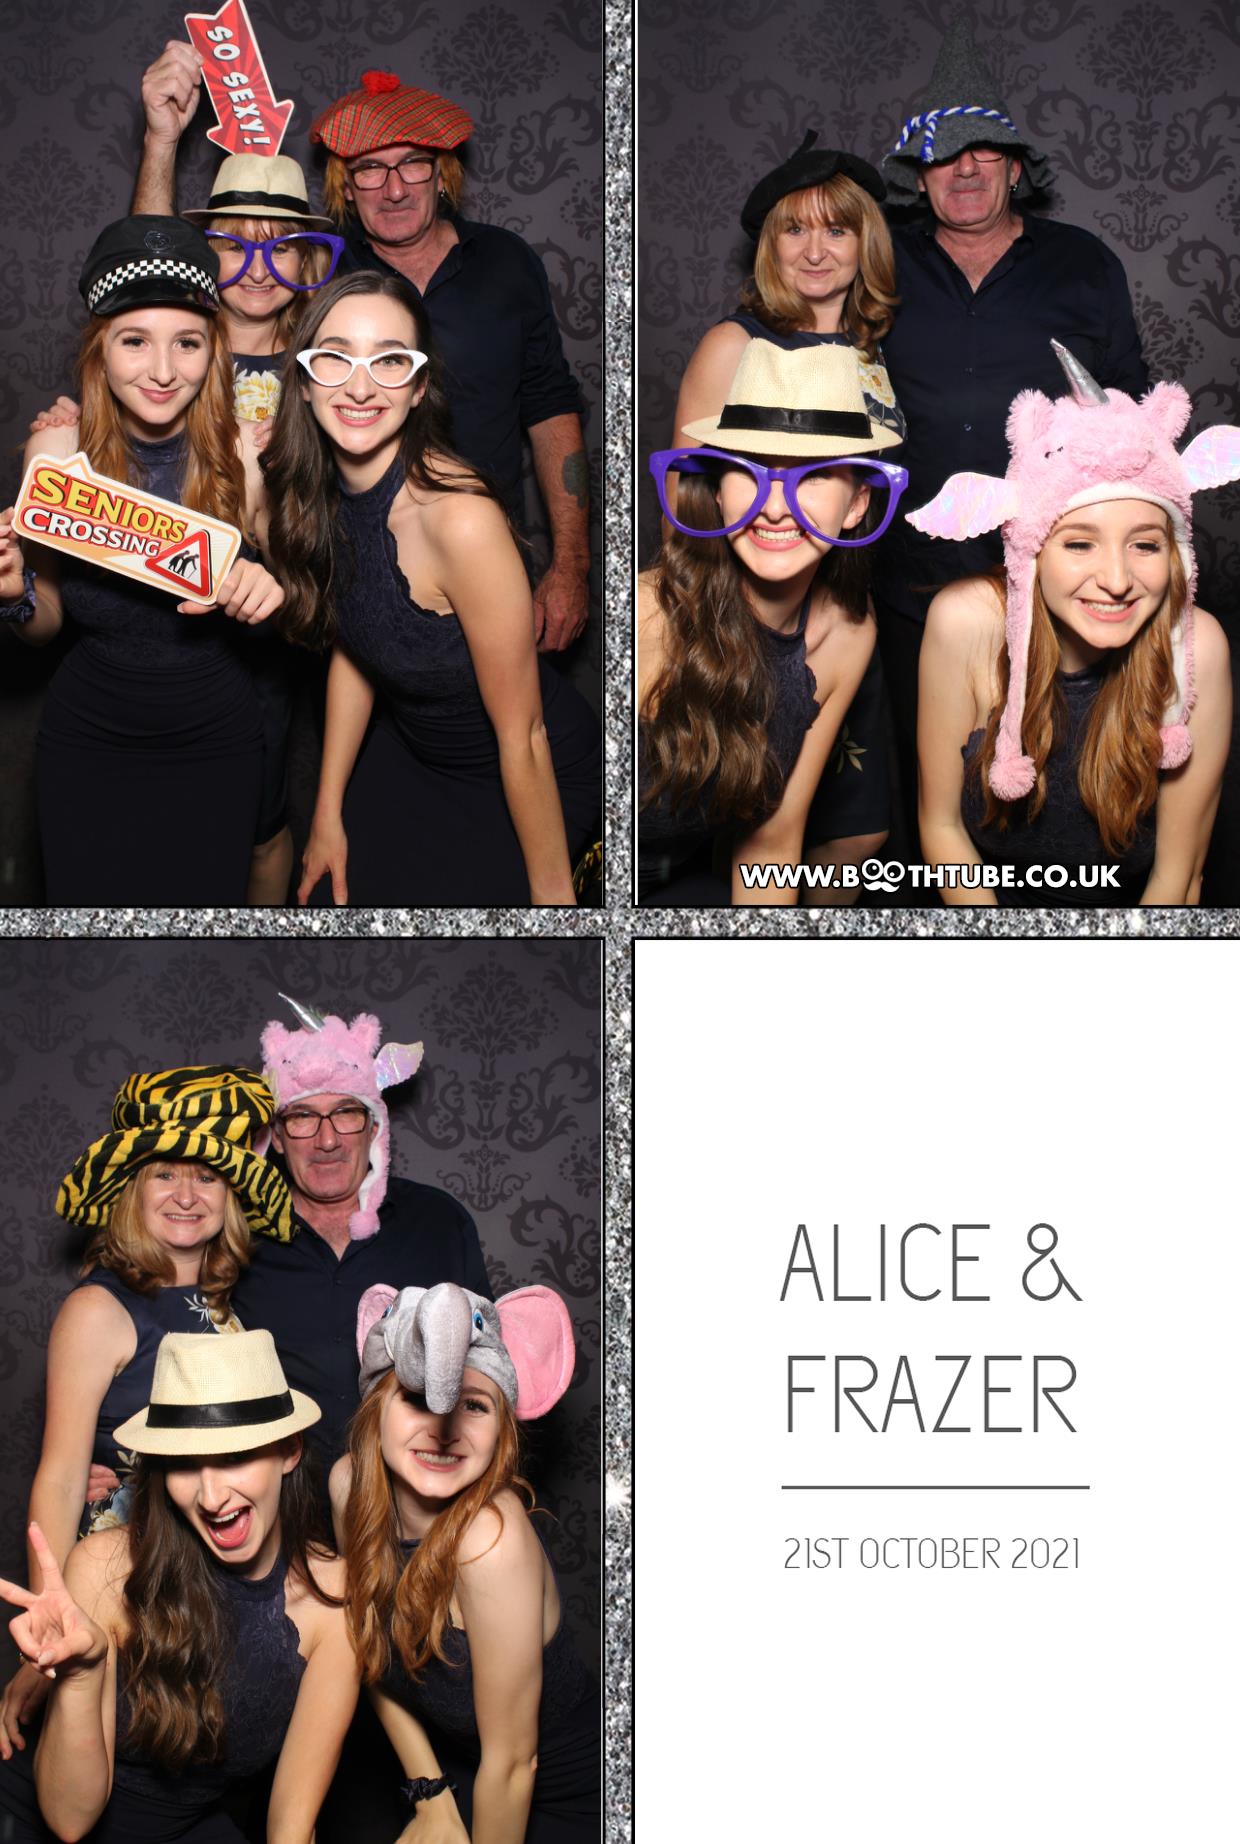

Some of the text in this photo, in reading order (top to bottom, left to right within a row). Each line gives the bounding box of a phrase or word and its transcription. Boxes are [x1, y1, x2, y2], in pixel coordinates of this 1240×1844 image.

[207, 26, 271, 145] SO SEXY!
[23, 508, 160, 556] CROSSING
[32, 469, 187, 543] SENIORS
